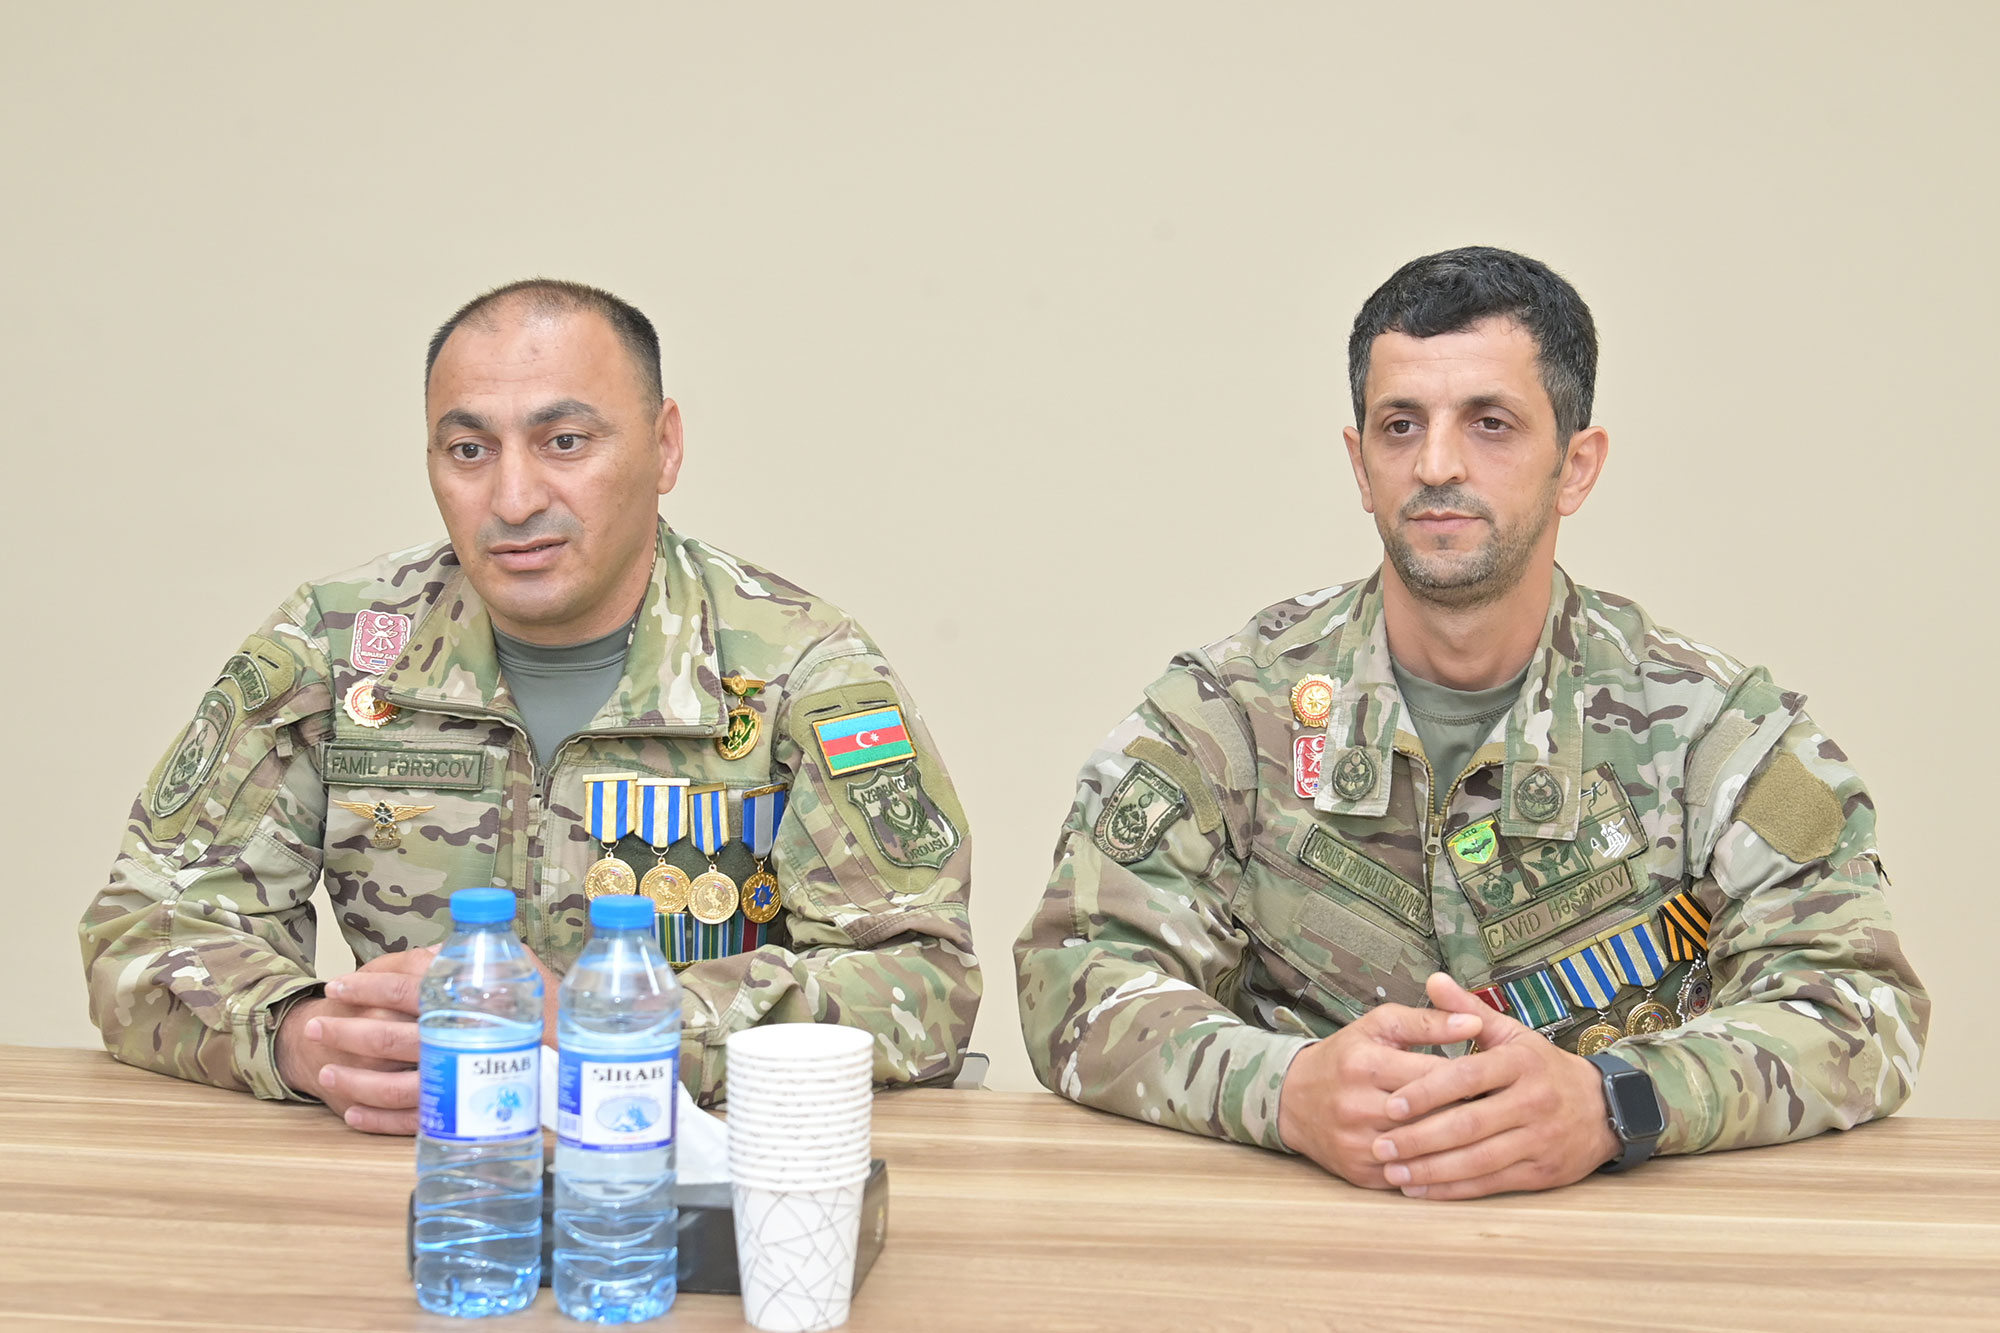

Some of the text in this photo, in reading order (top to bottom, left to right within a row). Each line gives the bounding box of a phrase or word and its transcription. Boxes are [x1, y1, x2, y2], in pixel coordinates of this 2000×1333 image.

[331, 752, 475, 778] FAMİL FƏRƏCOV
[904, 837, 949, 861] ORDUSU
[1487, 865, 1624, 950] CAVİD HƏSƏNOV
